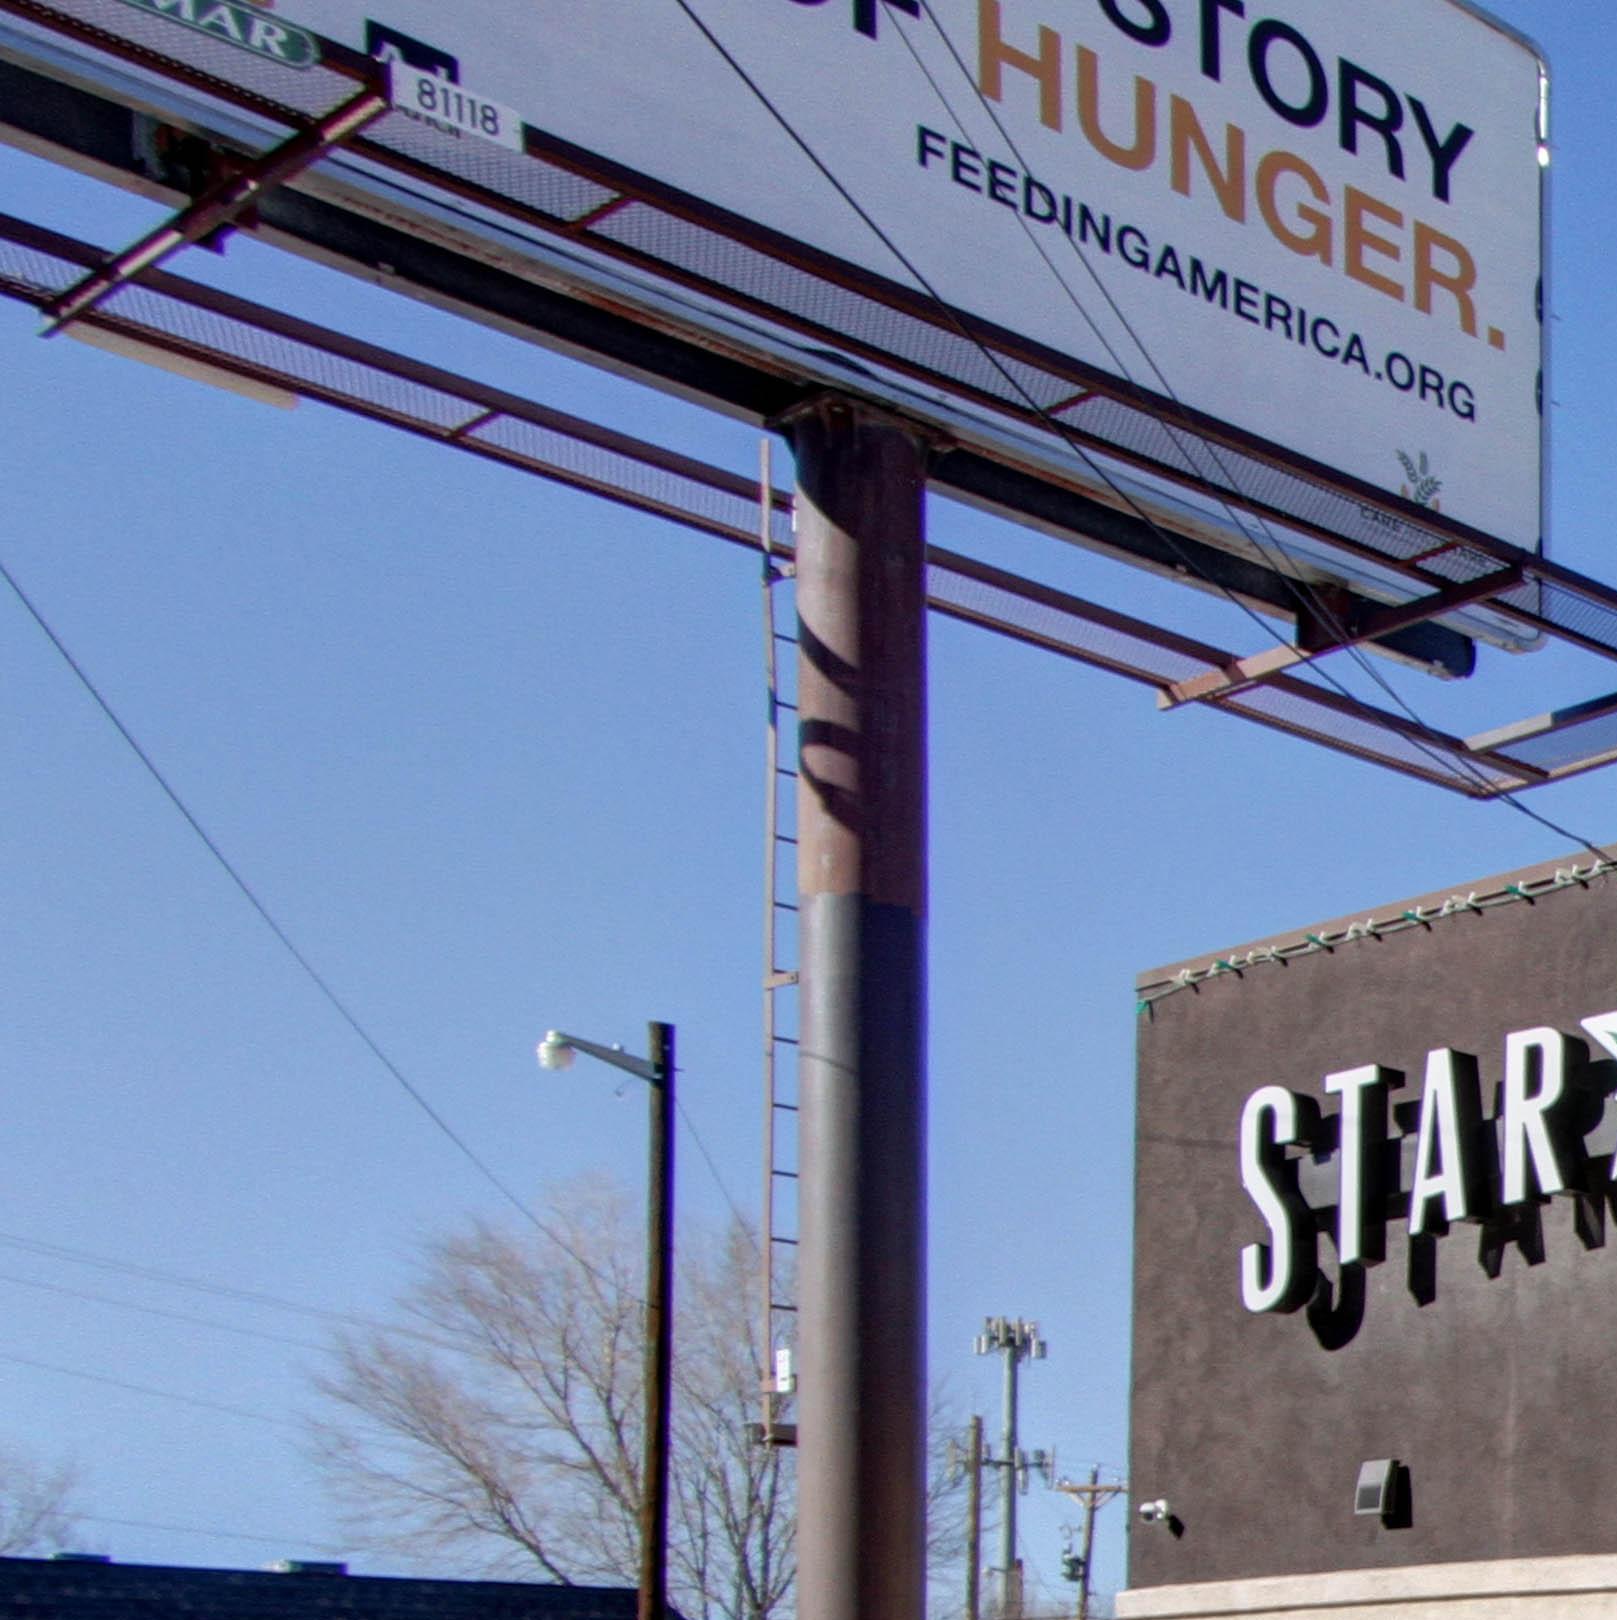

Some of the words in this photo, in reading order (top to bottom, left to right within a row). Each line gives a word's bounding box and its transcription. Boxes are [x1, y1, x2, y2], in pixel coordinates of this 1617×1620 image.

[415, 78, 501, 137] 81118
[978, 0, 1506, 351] HUNGER.
[917, 125, 1477, 422] FEEDINGAMERICA.ORG
[1240, 1026, 1566, 1313] STAR
